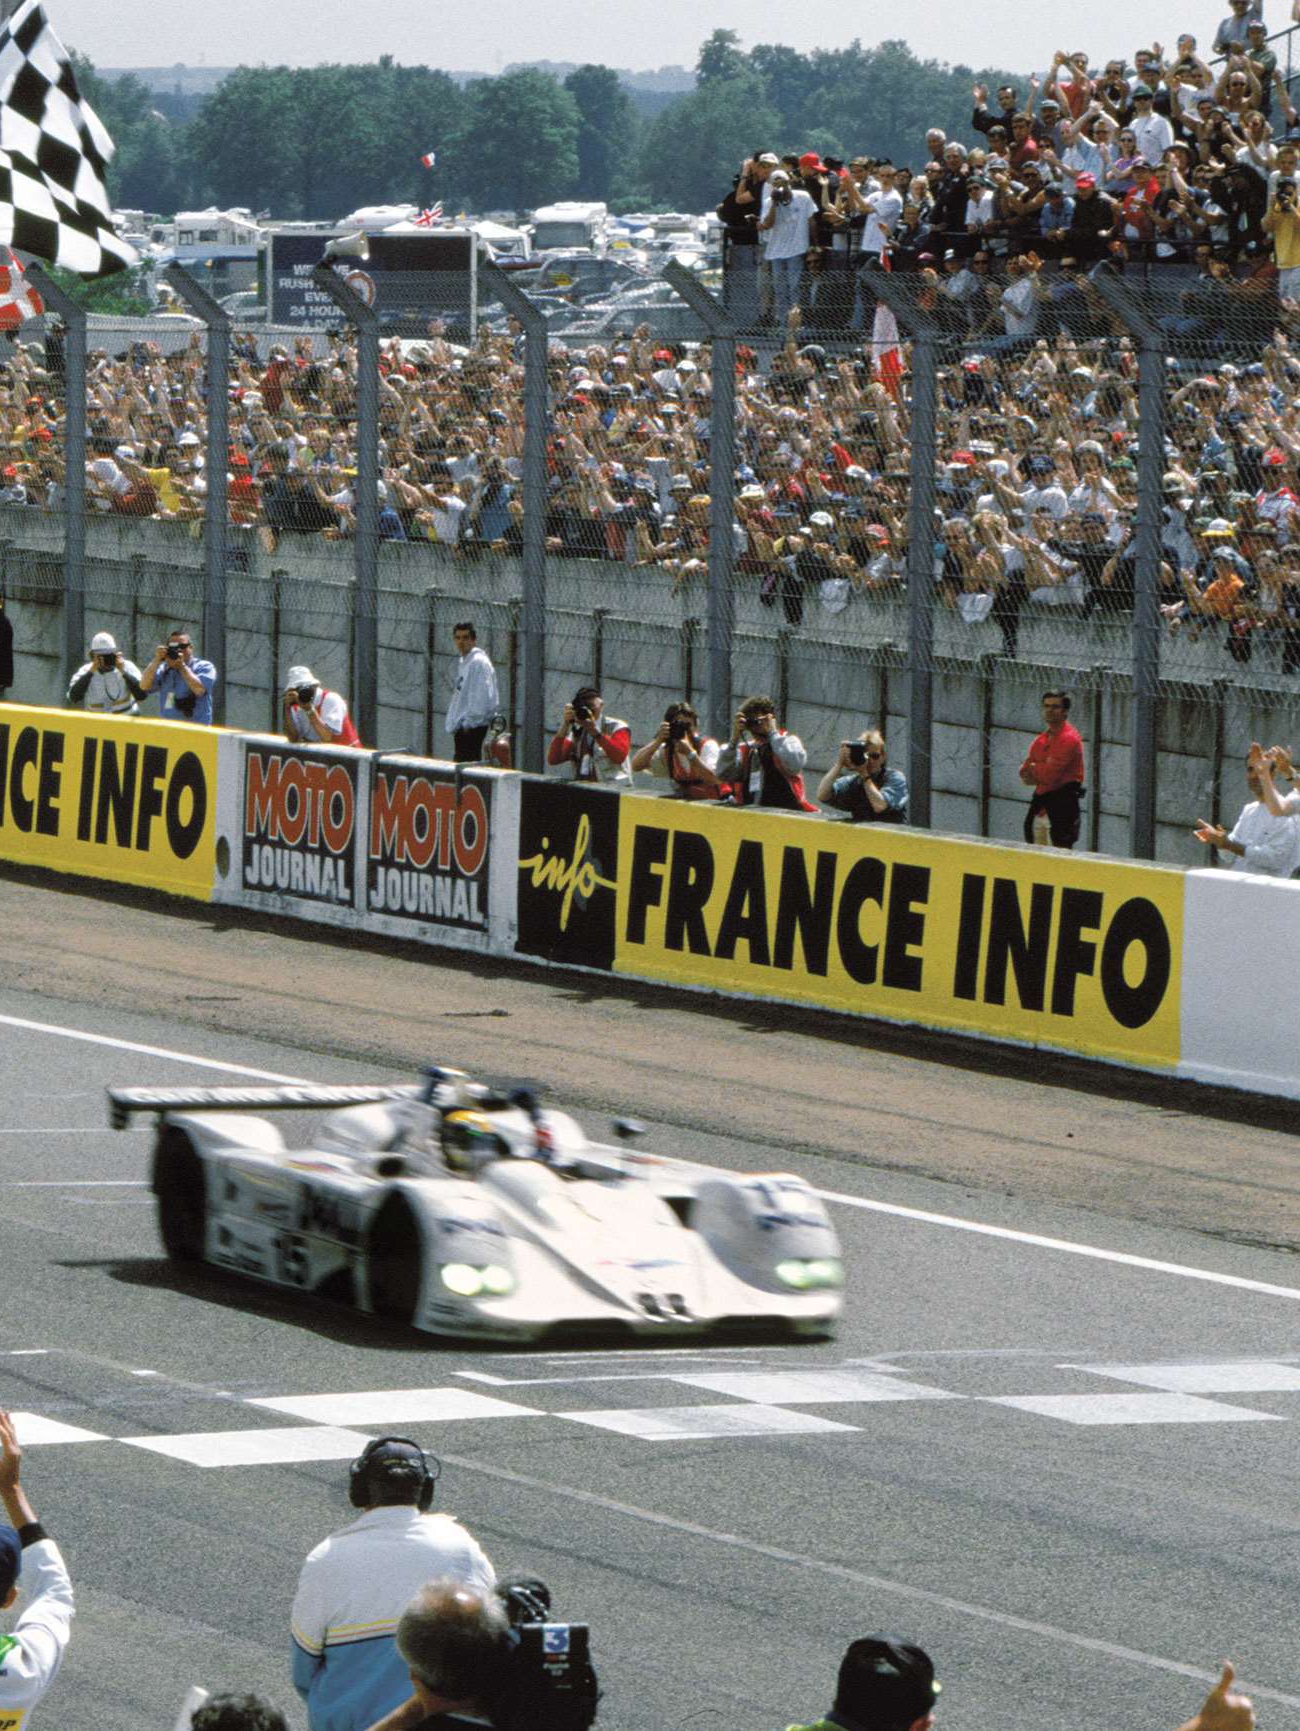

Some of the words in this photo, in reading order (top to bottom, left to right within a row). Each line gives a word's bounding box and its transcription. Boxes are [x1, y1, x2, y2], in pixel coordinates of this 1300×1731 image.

[280, 278, 314, 290] RUSH
[290, 306, 306, 317] 24
[77, 736, 207, 860] INFO
[245, 752, 355, 854] MOTO
[369, 772, 488, 877] MOTO
[245, 843, 350, 901] JOURNAL
[370, 865, 484, 925] JOURNAL
[519, 813, 617, 932] info
[626, 824, 931, 993] FRANCE
[953, 873, 1171, 1029] INFO
[546, 1627, 567, 1651] 3
